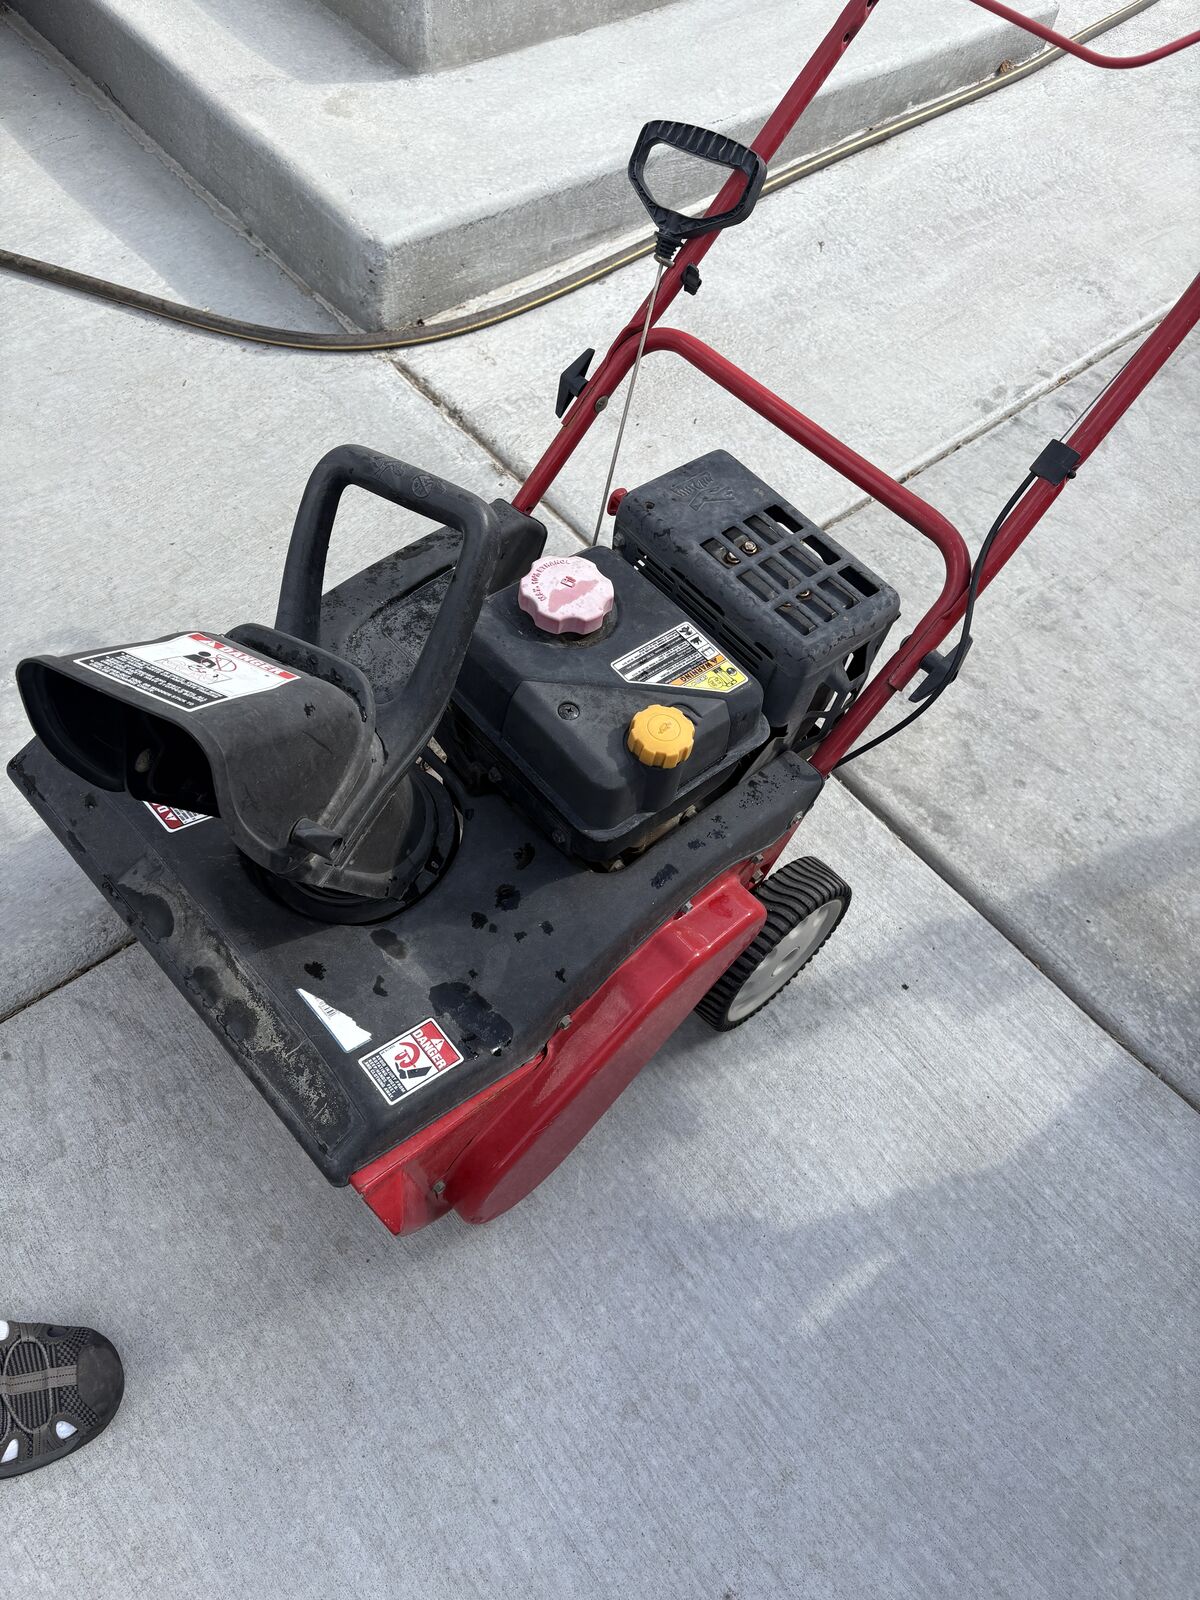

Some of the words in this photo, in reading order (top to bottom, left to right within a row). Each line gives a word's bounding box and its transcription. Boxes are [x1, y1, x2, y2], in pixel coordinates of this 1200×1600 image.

[220, 643, 282, 676] DANGER
[680, 660, 713, 682] WARNING
[411, 1028, 447, 1069] DANGER
[370, 1056, 388, 1077] ROTATING
[369, 1068, 385, 1088] CLOTHING
[383, 1066, 396, 1080] INJURY
[394, 1079, 406, 1093] FROM
[385, 1083, 396, 1094] FEET
